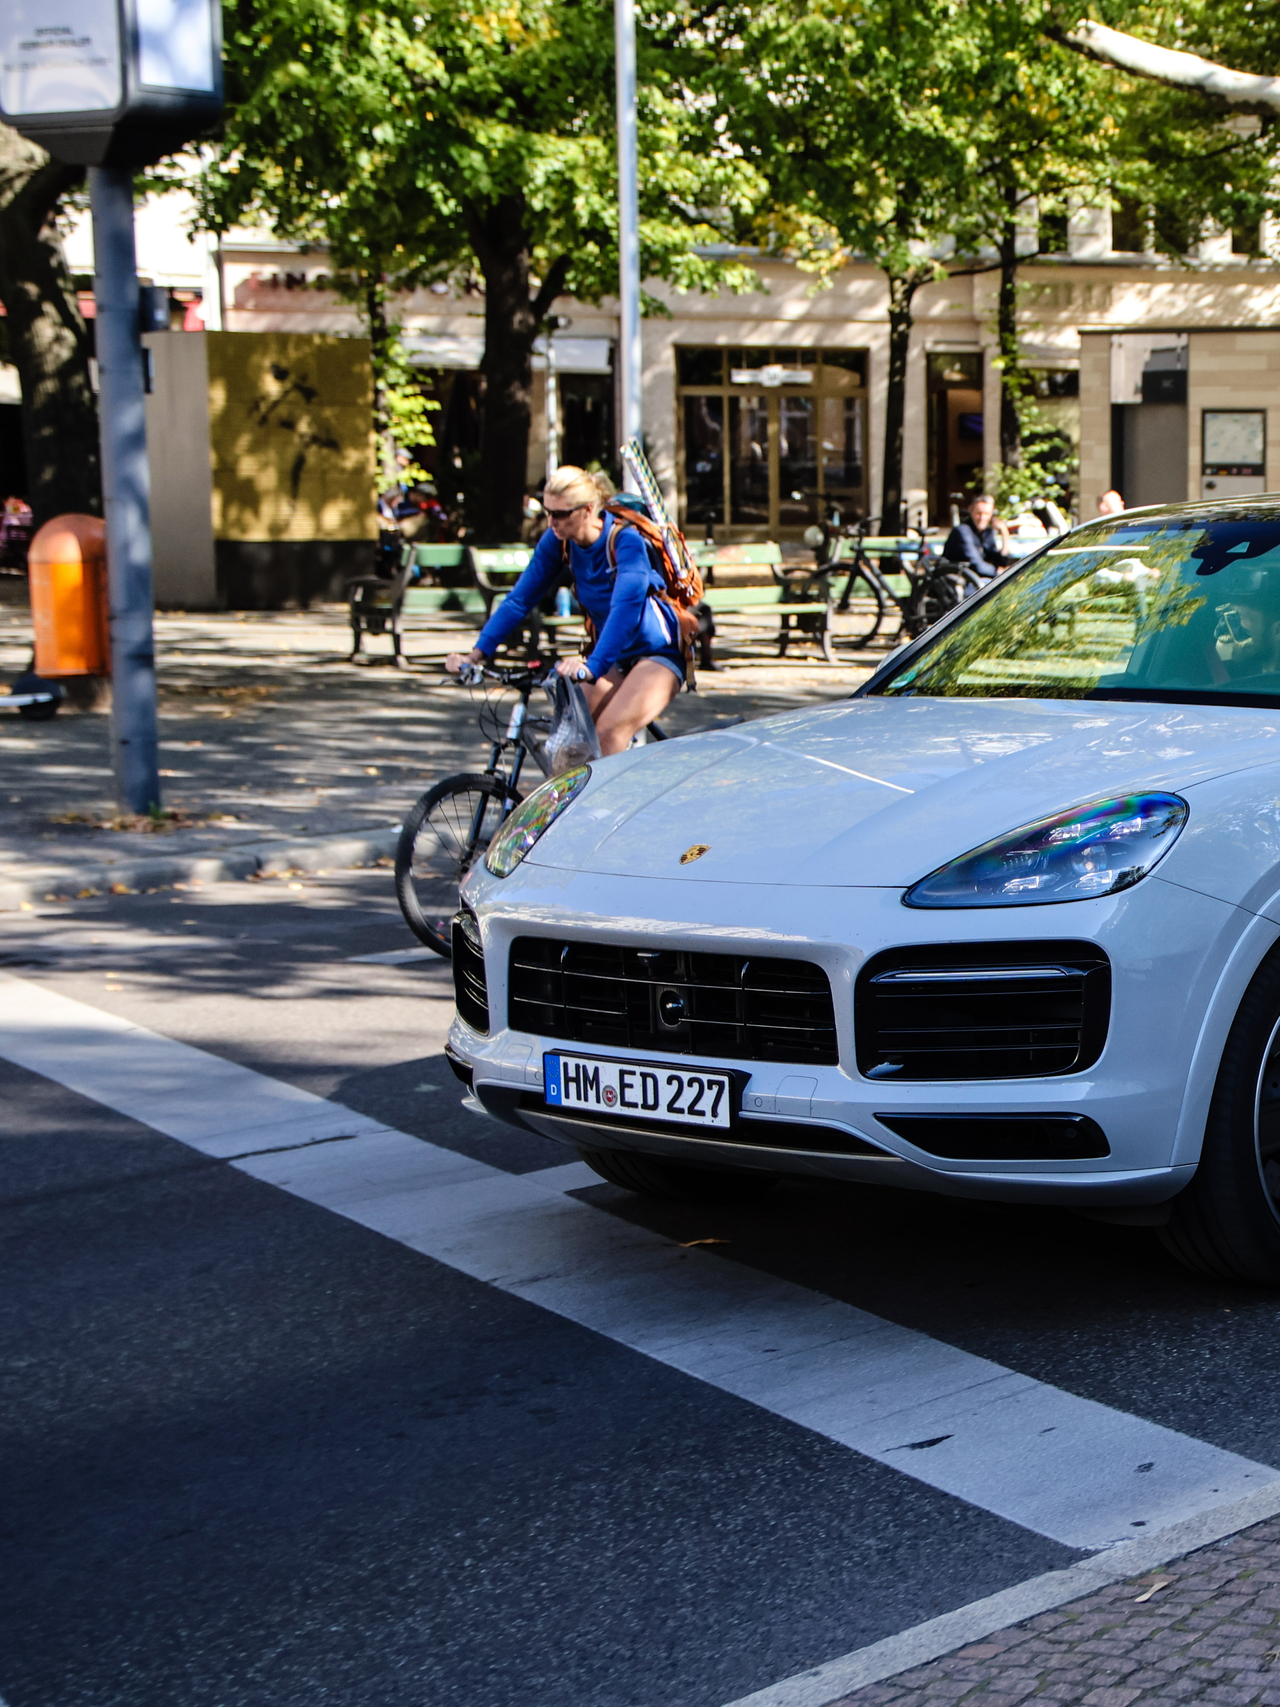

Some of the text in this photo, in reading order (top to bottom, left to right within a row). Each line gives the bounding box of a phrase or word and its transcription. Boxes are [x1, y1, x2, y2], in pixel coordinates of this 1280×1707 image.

[551, 1084, 558, 1096] D
[562, 1061, 726, 1118] HM ED 227
